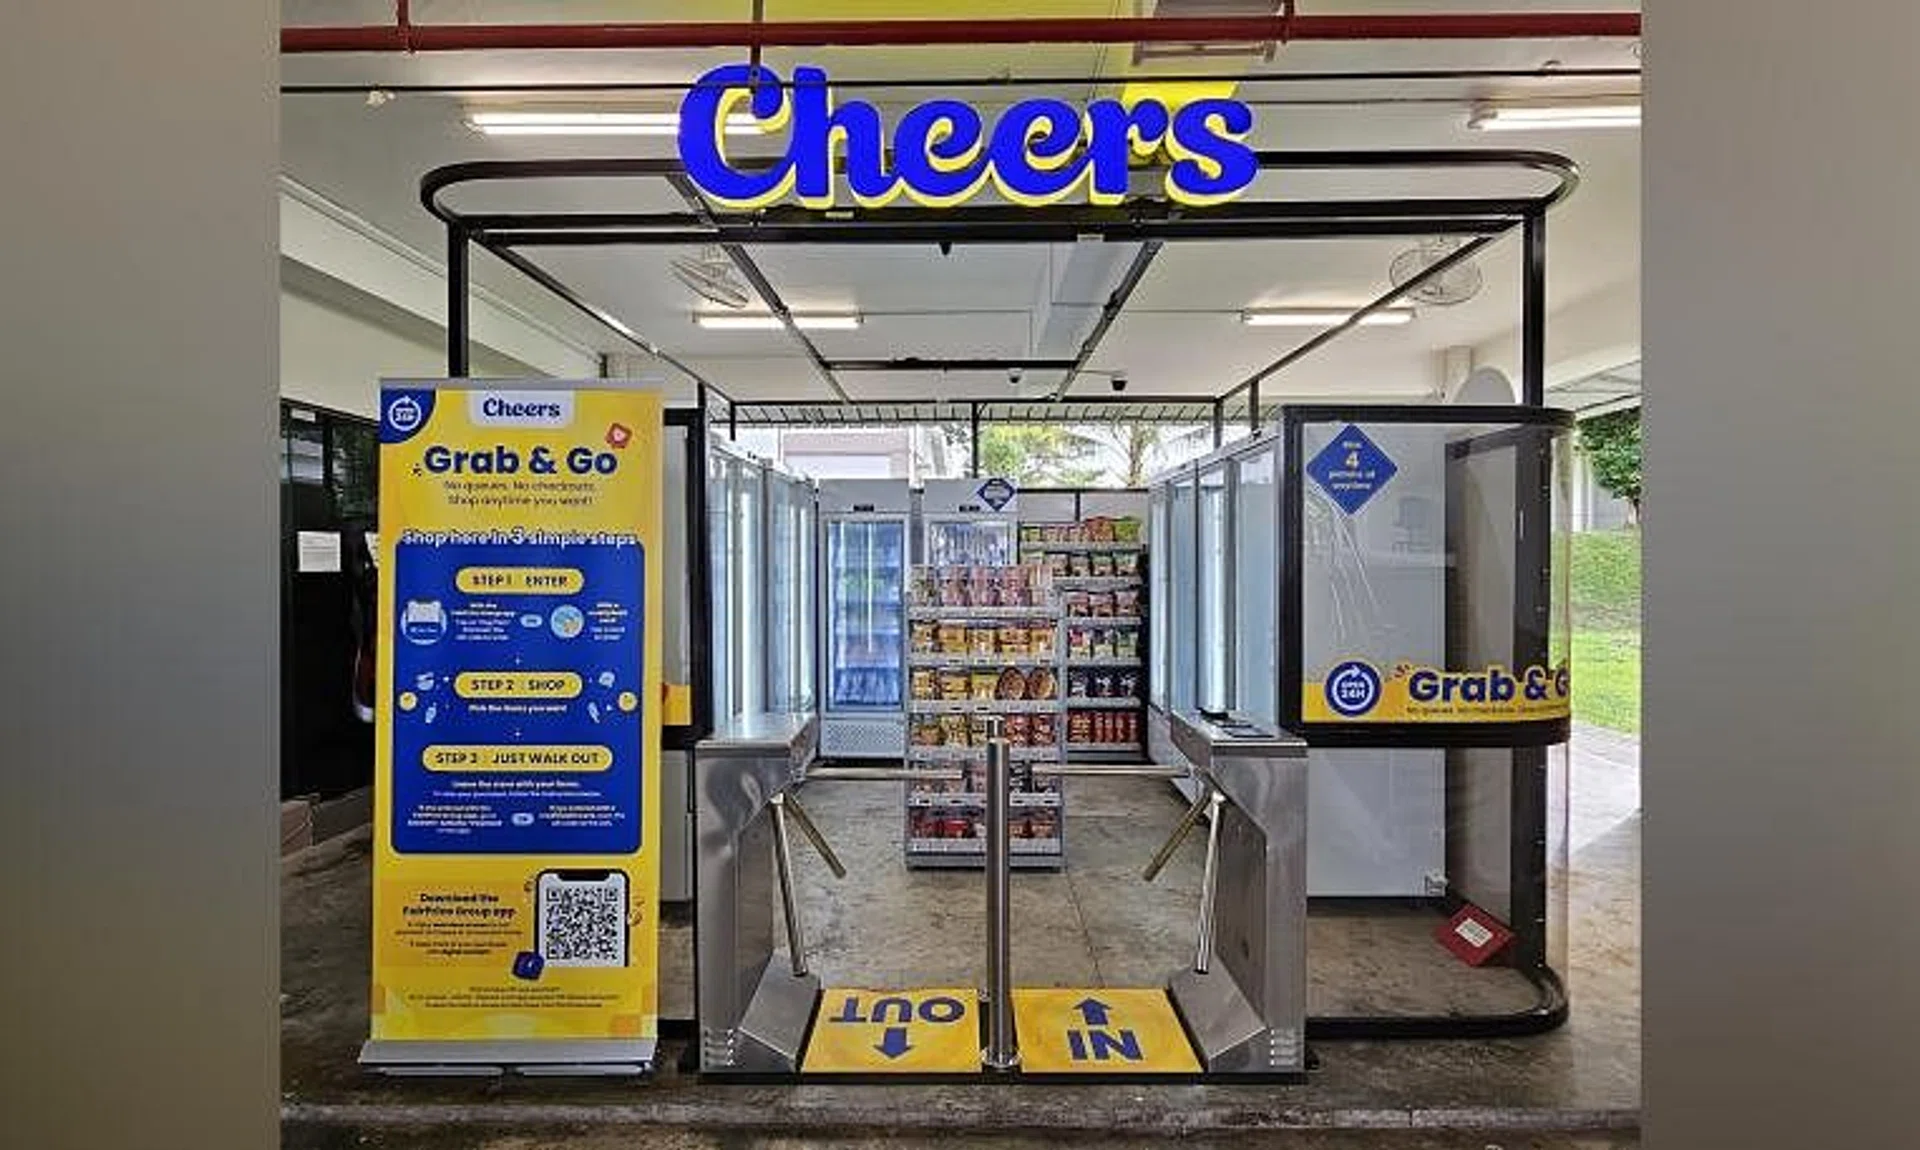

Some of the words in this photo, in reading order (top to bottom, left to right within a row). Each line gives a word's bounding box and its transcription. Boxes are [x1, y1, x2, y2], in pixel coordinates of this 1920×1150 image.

[678, 63, 1260, 207] Cheers
[482, 397, 561, 417] Cheers
[424, 446, 519, 475] Grab
[529, 446, 557, 475] &
[567, 446, 618, 475] Go
[1345, 450, 1359, 469] 4
[449, 494, 478, 509] Shop
[403, 528, 446, 548] Shop
[450, 529, 483, 545] here
[511, 526, 525, 546] 3
[529, 529, 586, 549] simple
[589, 532, 637, 549] steps
[472, 575, 504, 586] STEP
[525, 575, 568, 586] ENTER
[470, 679, 503, 690] STEP
[505, 679, 513, 690] 2
[527, 679, 565, 690] SHOP
[1409, 669, 1514, 702] Grab
[1524, 669, 1548, 700] &
[435, 752, 470, 764] STEP
[492, 752, 526, 764] JUST
[530, 752, 567, 764] WALK
[571, 752, 598, 764] OUT
[829, 996, 965, 1023] OUT
[1067, 1029, 1143, 1061] IN
